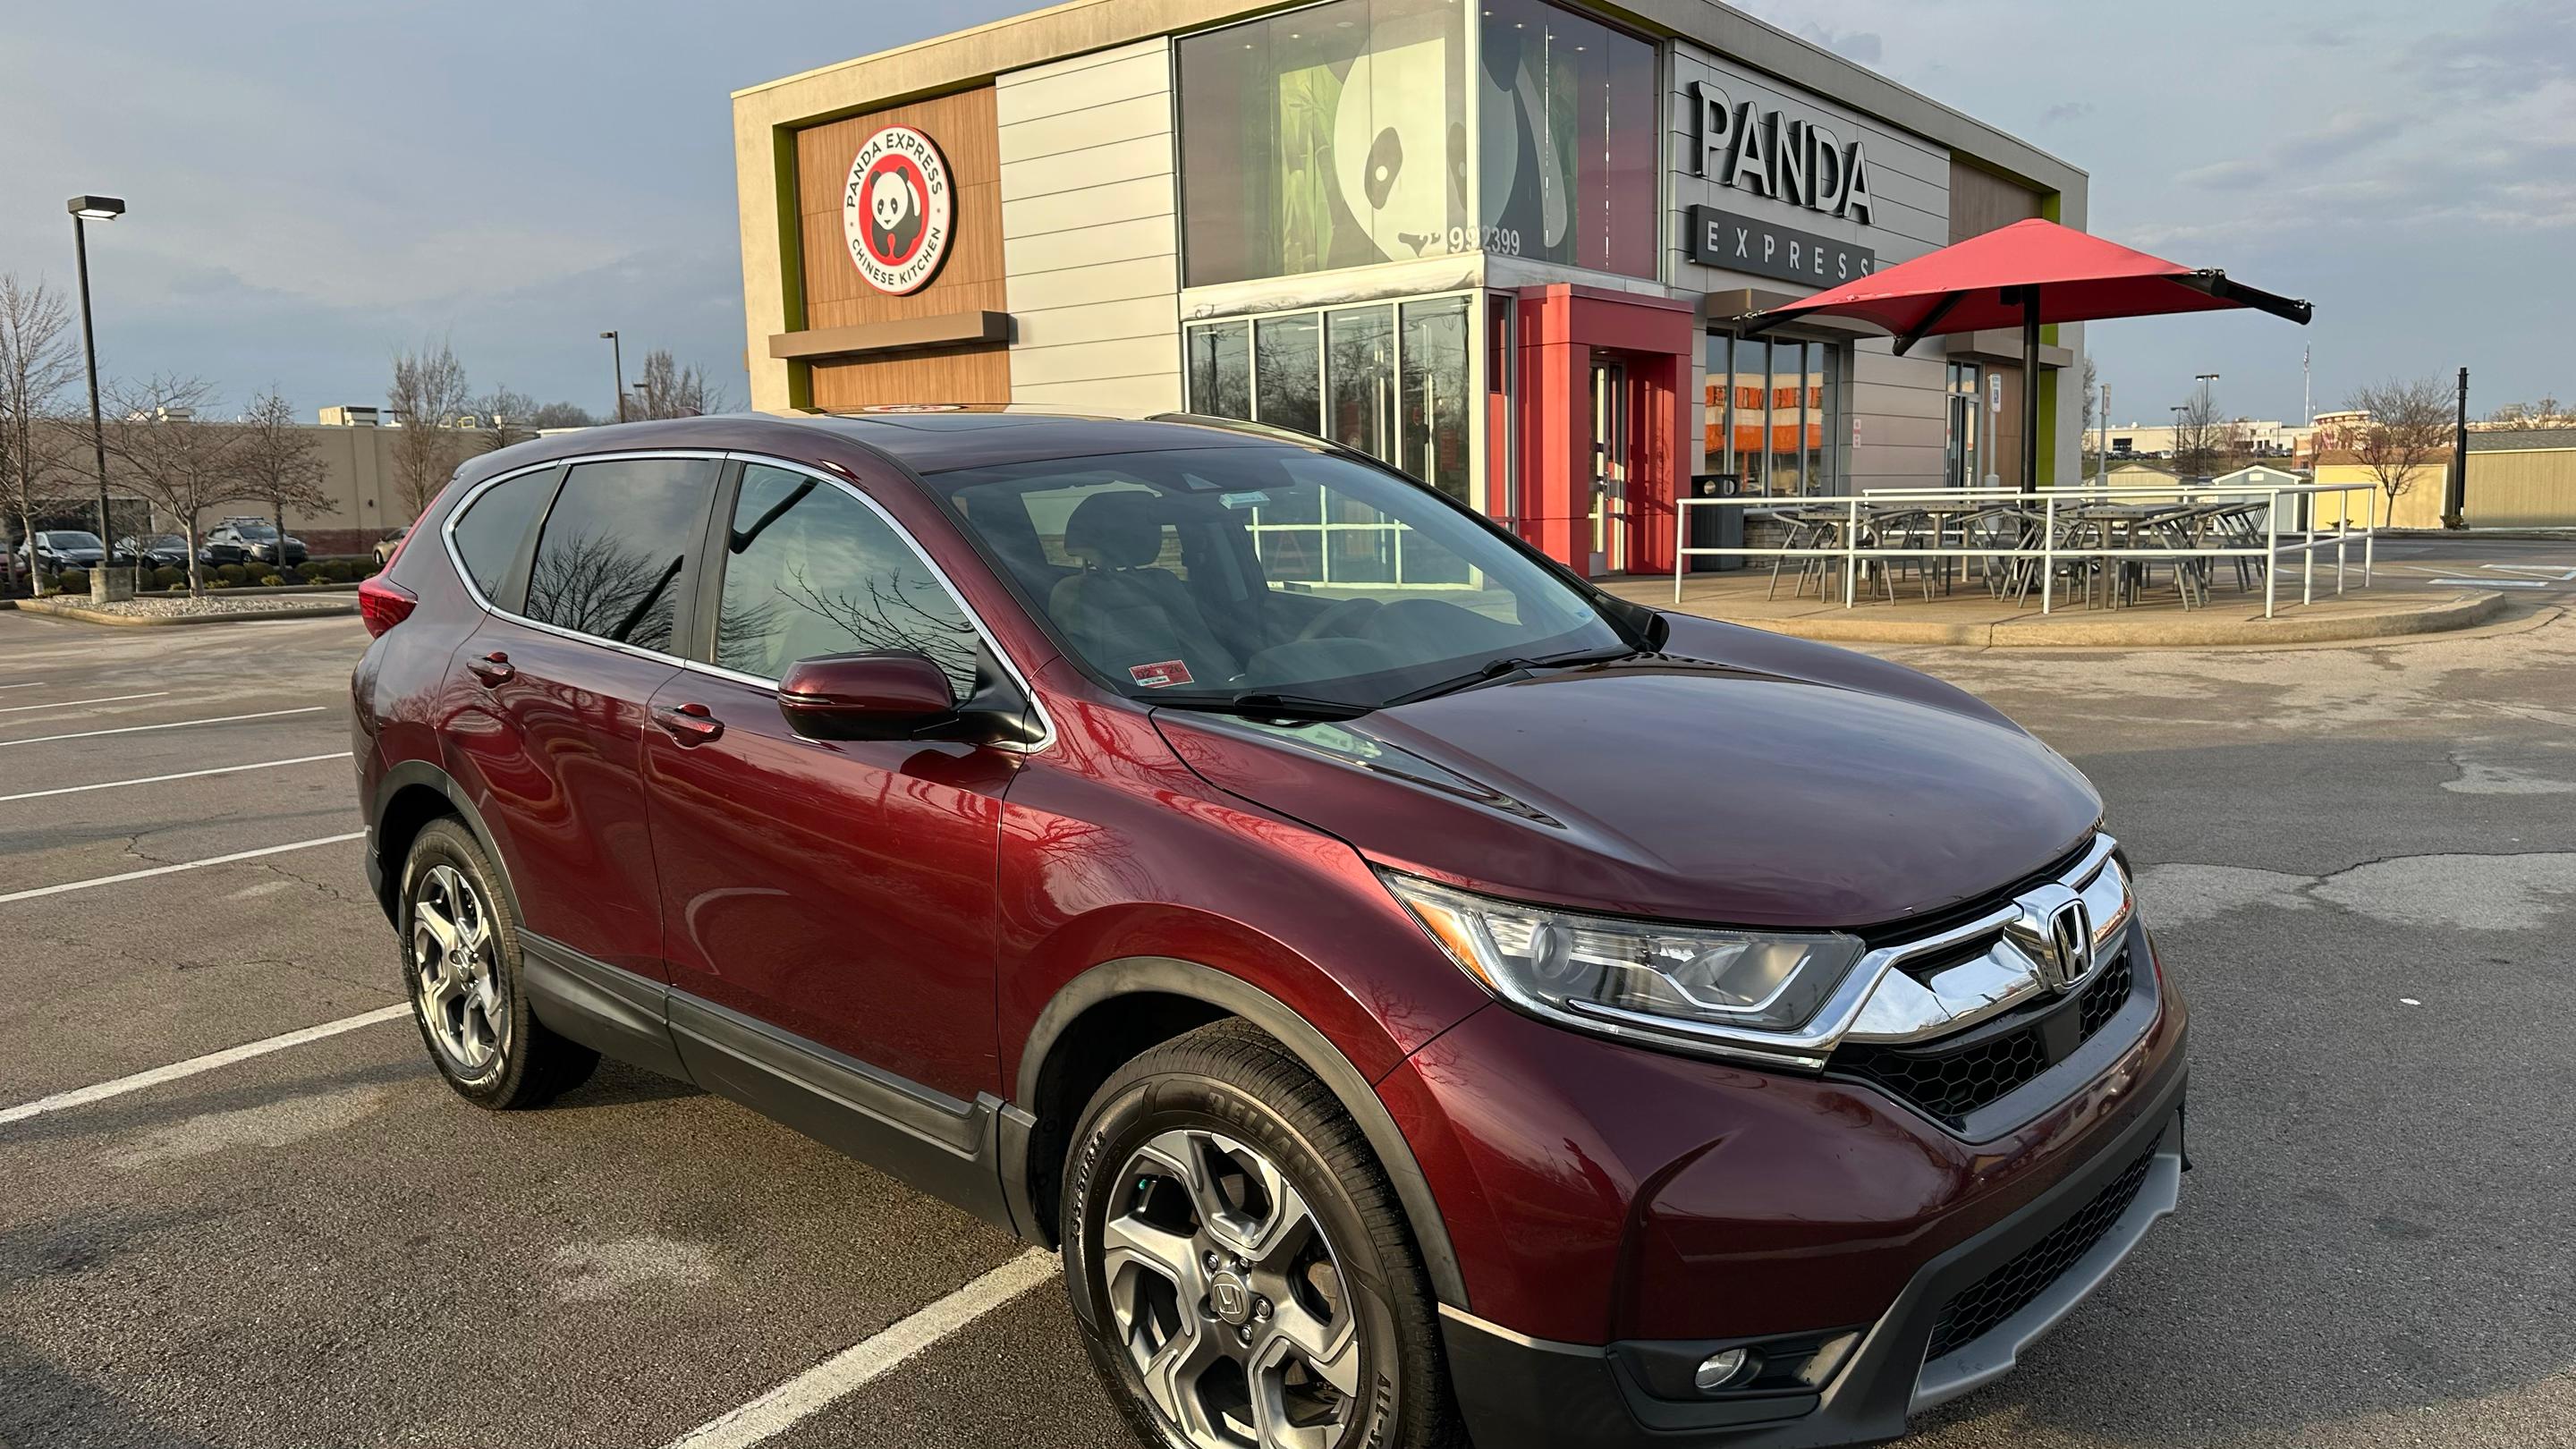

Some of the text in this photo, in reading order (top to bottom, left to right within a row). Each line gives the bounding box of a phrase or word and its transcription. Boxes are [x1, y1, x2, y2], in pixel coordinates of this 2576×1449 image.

[846, 132, 943, 208] PANDA EXPRESS
[1691, 80, 1876, 225] PANDA
[852, 226, 942, 285] CHINESE KITCHEN
[1707, 220, 1869, 280] EXPRESS
